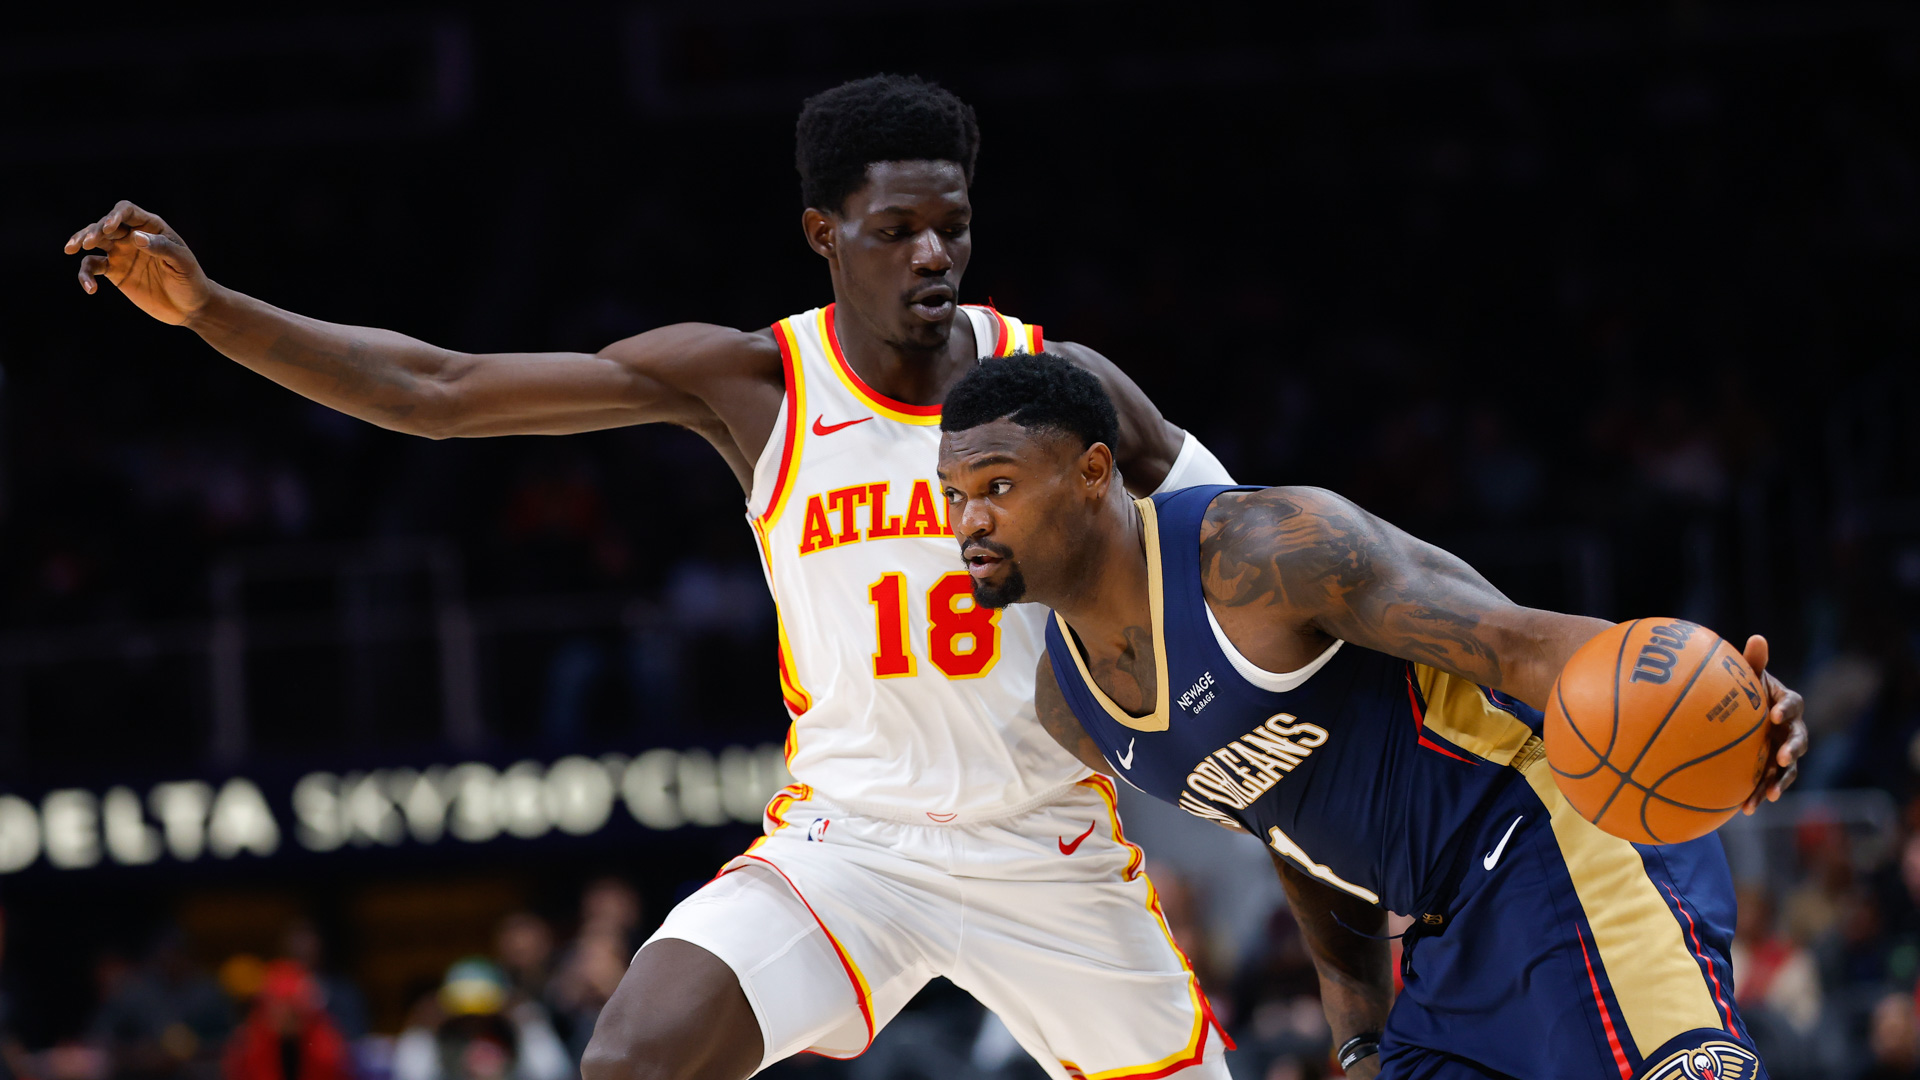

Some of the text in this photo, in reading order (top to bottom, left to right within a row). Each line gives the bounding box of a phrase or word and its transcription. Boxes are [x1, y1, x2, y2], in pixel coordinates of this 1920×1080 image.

[799, 479, 955, 557] ATLA
[868, 571, 1003, 680] 18
[1177, 671, 1215, 711] NEWAGE
[1193, 691, 1215, 714] GARAGE
[1187, 713, 1329, 810] ORLEANS
[0, 776, 282, 874] DELTA
[620, 744, 790, 831] CLU
[1269, 825, 1379, 904] 1
